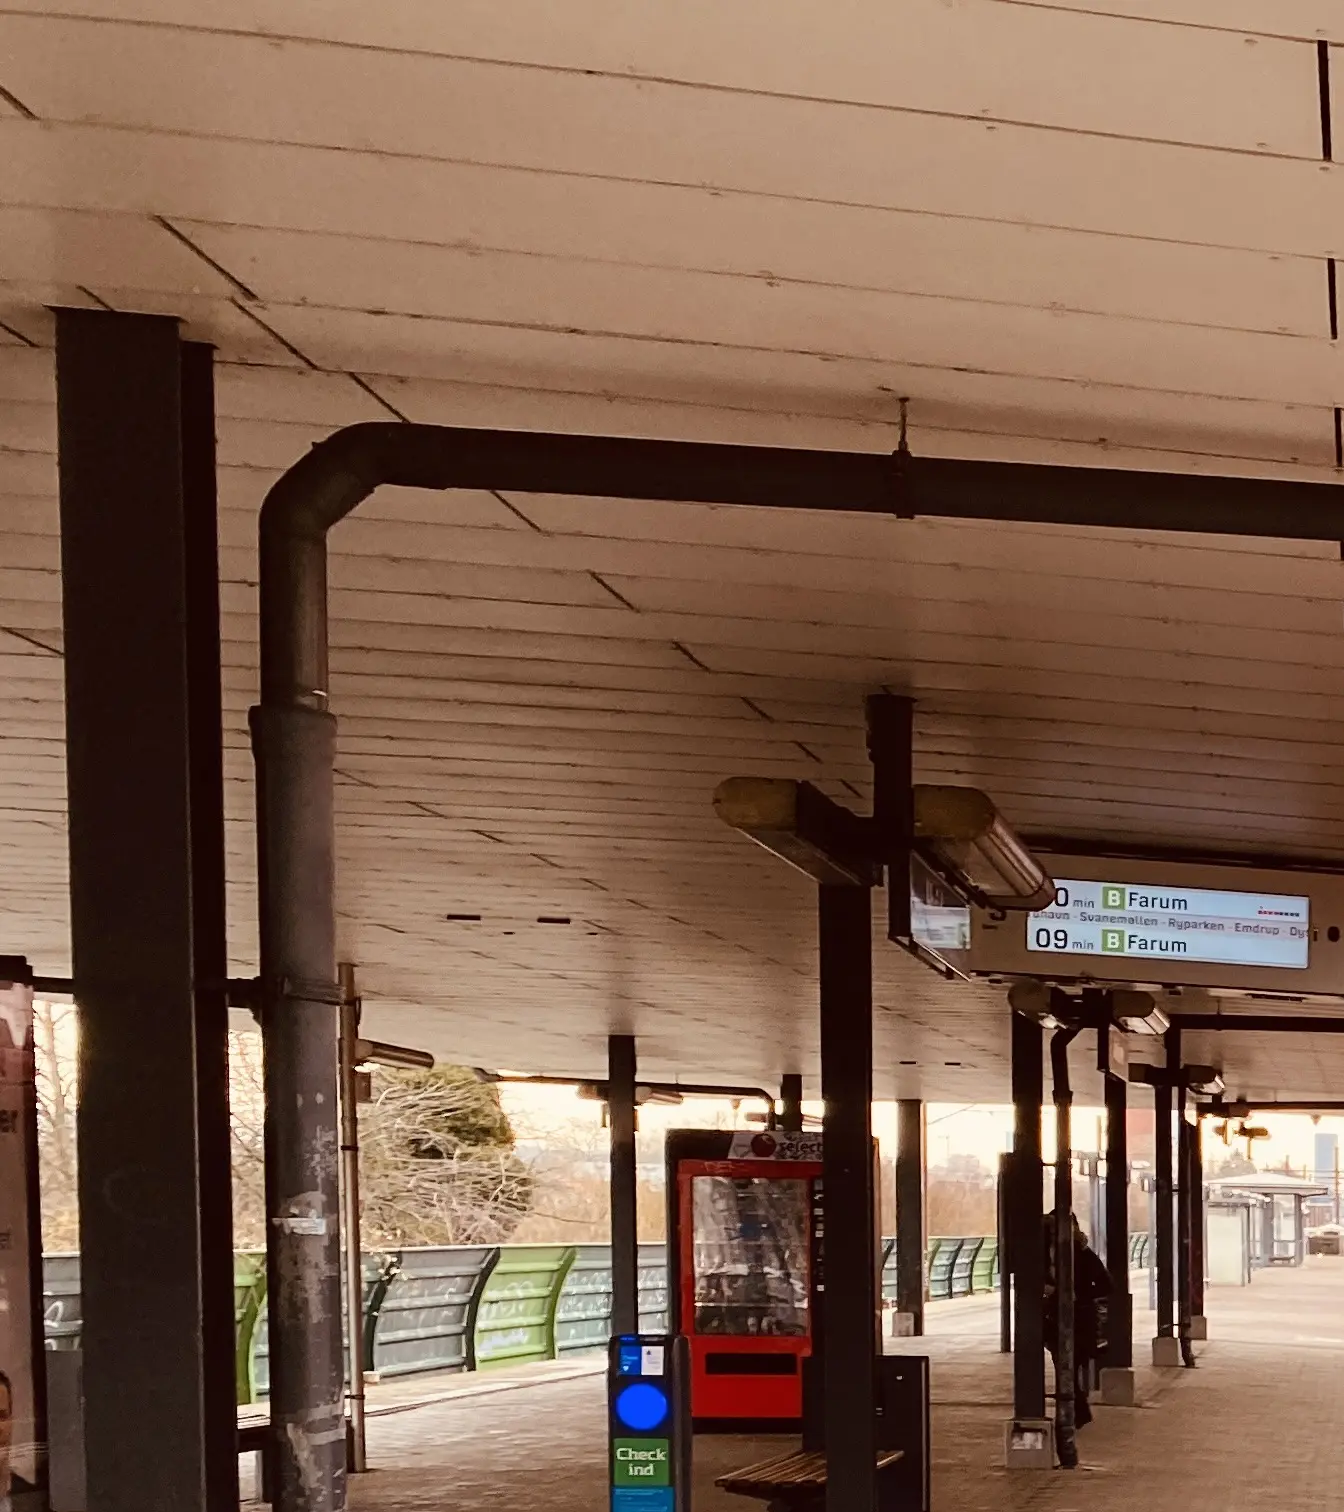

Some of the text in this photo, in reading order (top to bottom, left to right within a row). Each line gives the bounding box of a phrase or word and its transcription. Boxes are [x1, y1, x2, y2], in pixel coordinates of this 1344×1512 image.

[1072, 898, 1095, 909] min
[1107, 889, 1121, 907] B
[1129, 891, 1188, 911] Farum
[1168, 917, 1225, 931] Ryparken
[1234, 922, 1280, 936] Emdrup
[1036, 928, 1187, 953] 09 min B Farum
[616, 1447, 667, 1461] Check
[628, 1462, 655, 1476] ind
